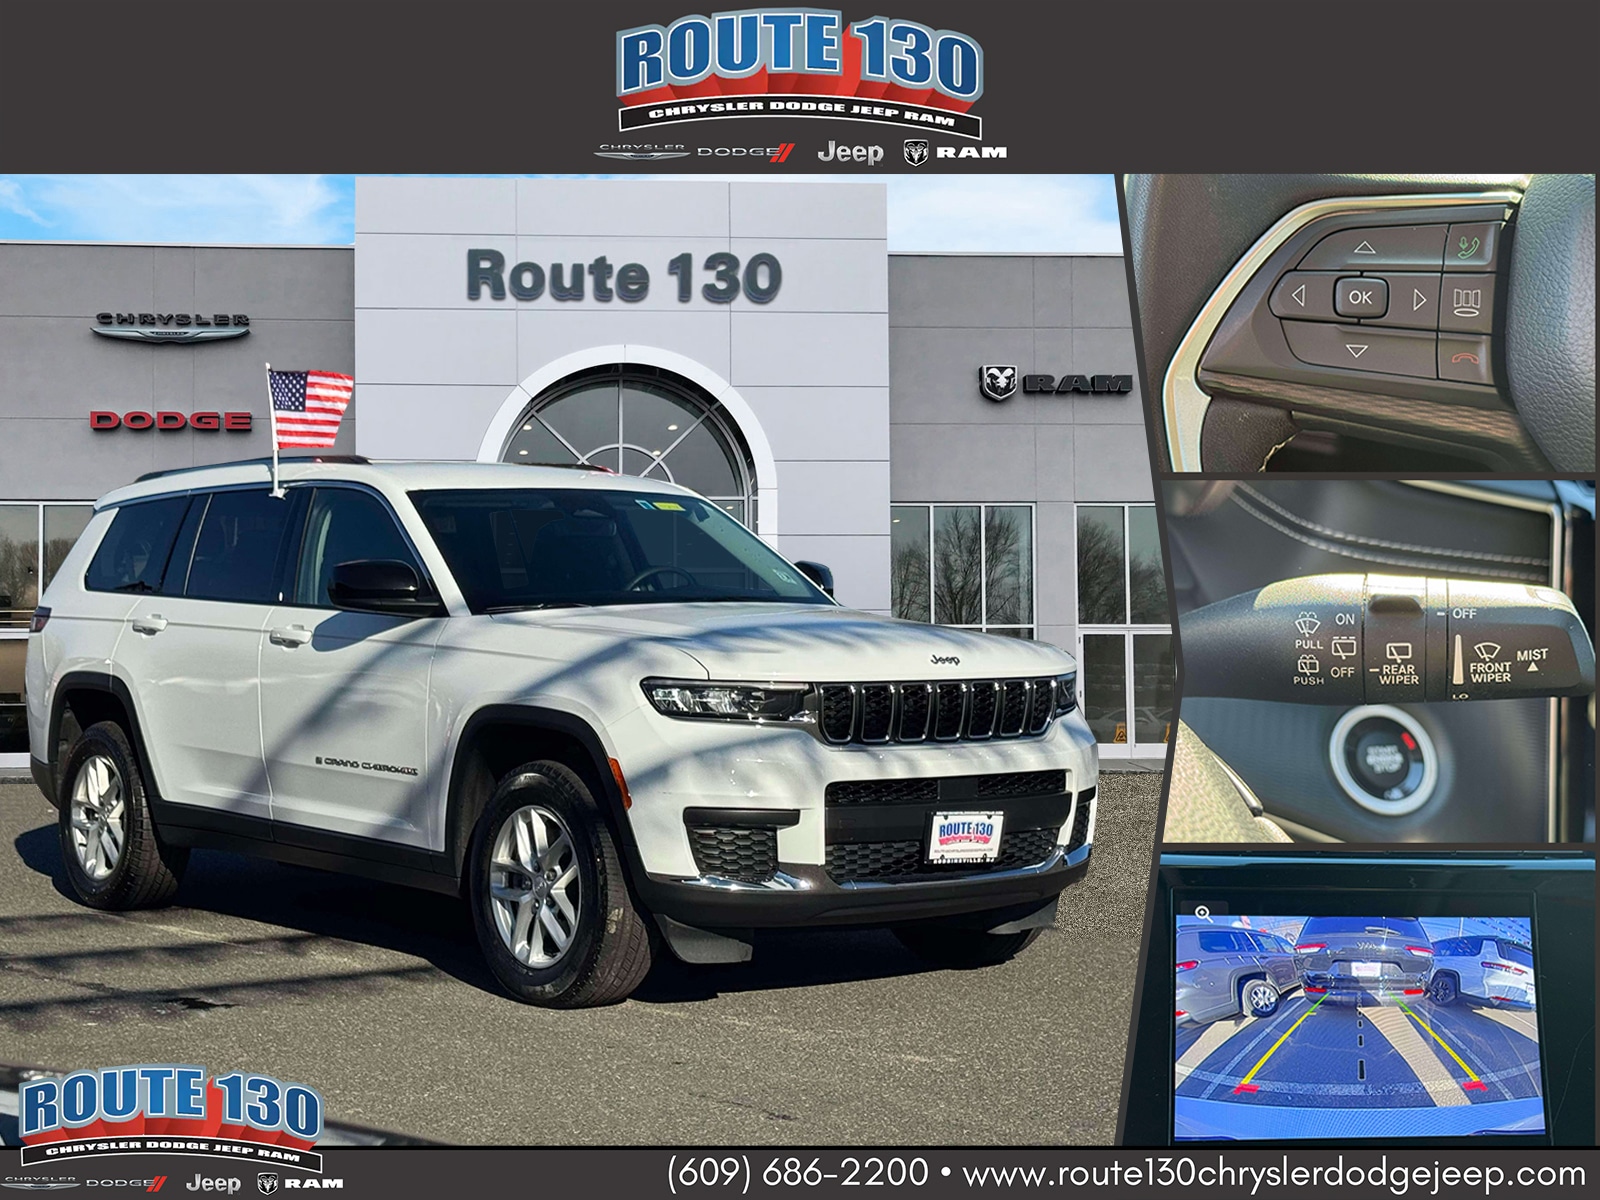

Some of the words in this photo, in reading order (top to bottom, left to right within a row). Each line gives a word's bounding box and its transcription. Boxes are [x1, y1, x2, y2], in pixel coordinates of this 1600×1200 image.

[467, 248, 650, 302] Route
[667, 251, 782, 305] 130
[1349, 289, 1373, 305] OK
[96, 312, 250, 326] CHRYSLER
[1023, 374, 1133, 394] RAM
[90, 410, 252, 431] DODGE
[1335, 612, 1355, 626] ON
[1452, 608, 1477, 620] OFF
[1294, 639, 1324, 650] PULL
[930, 654, 961, 666] Jeep
[1516, 648, 1549, 662] MIST
[1330, 666, 1355, 679] OFF
[1382, 664, 1415, 675] REAR
[1469, 662, 1512, 673] FRONT
[1293, 676, 1325, 685] PUSH
[1378, 675, 1420, 685] WIPER
[1470, 672, 1512, 683] WIPER
[939, 822, 972, 838] ROUTE
[975, 823, 993, 837] 130
